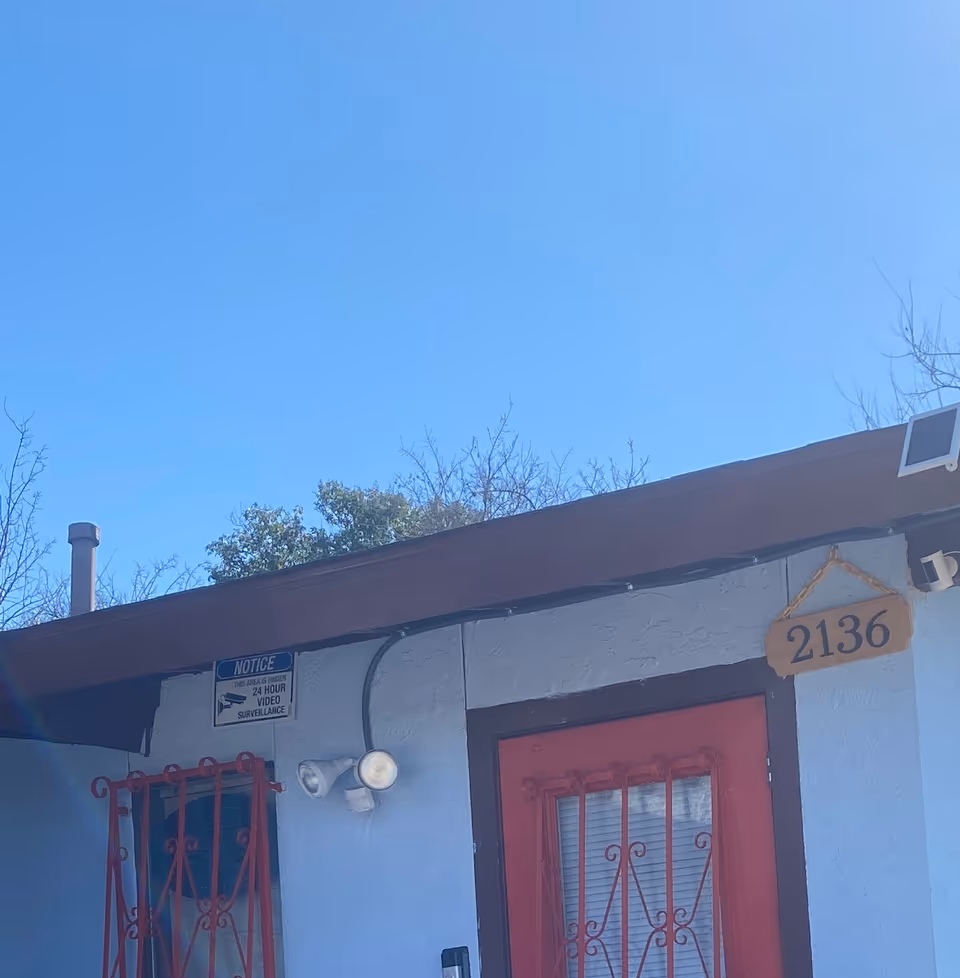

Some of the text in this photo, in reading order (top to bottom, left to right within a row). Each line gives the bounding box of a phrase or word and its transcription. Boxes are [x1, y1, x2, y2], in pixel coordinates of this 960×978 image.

[787, 609, 891, 664] 2136
[234, 656, 276, 675] NOTICE
[252, 683, 286, 696] 24 HOUR
[257, 695, 281, 707] VIDEO
[238, 705, 285, 719] SURVEILLANCE
